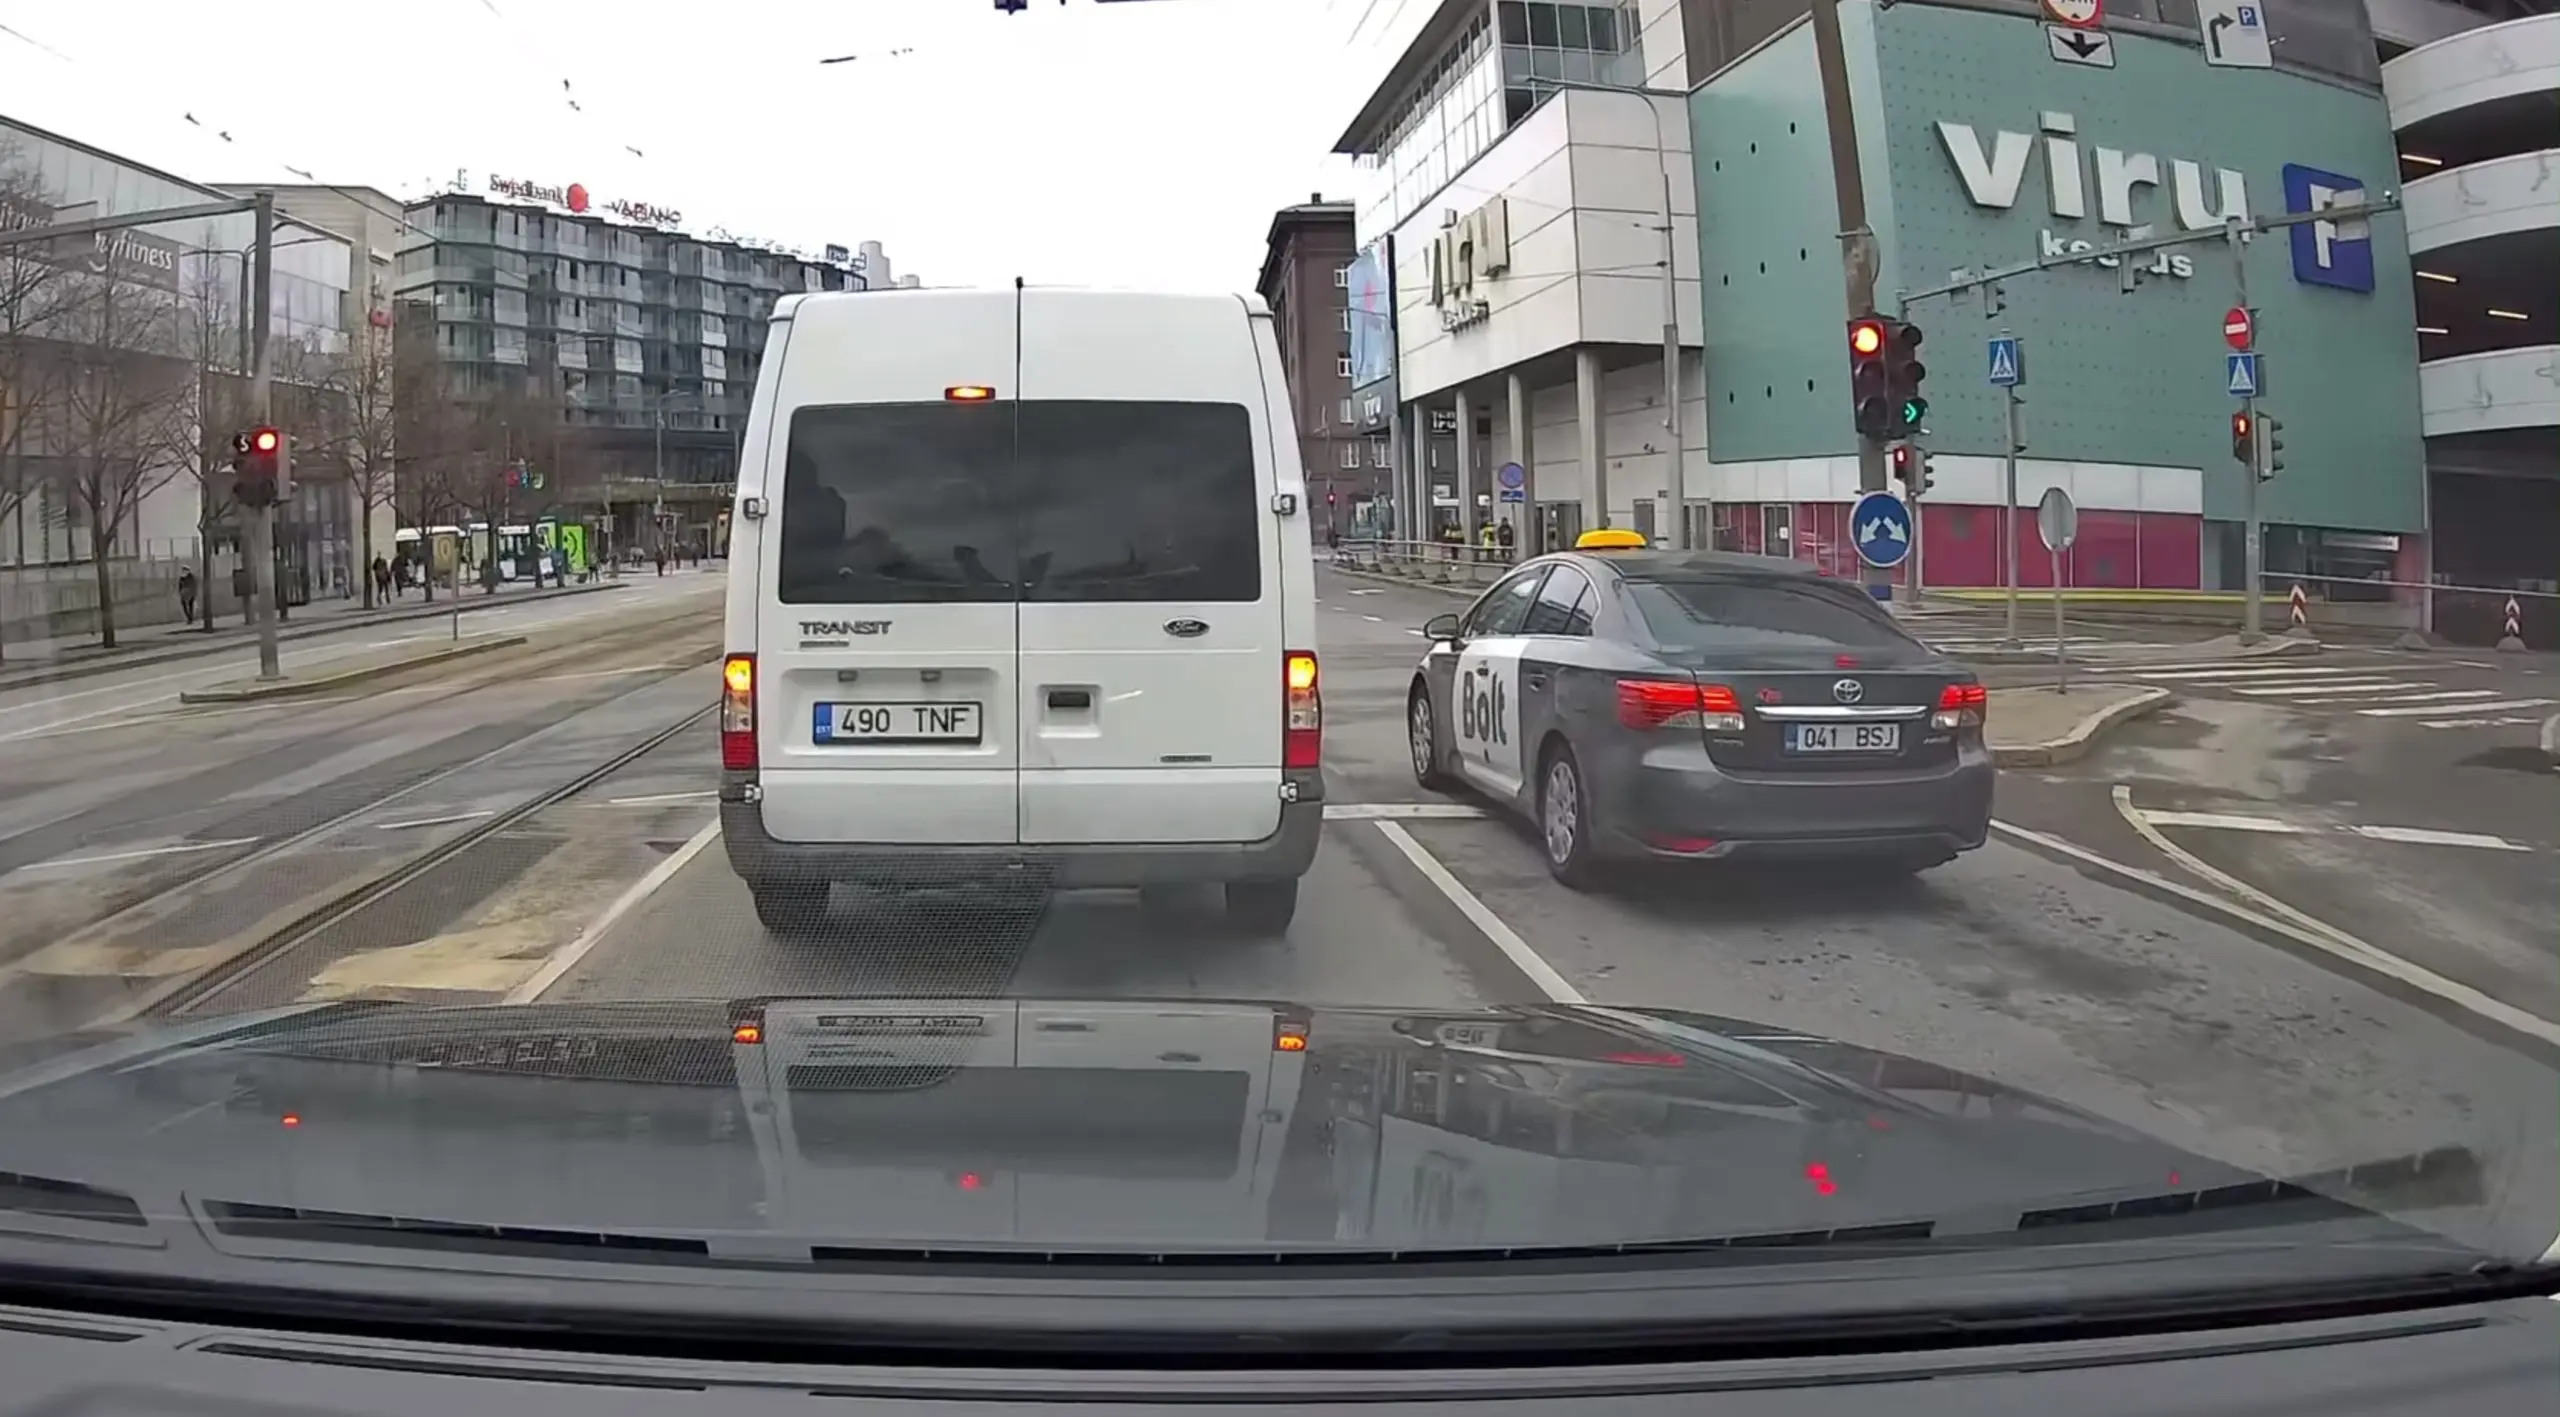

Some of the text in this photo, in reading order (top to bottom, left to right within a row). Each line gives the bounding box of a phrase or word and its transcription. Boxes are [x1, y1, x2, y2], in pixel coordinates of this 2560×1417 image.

[490, 173, 564, 204] Swedbank
[1935, 110, 2251, 243] viru
[798, 620, 893, 635] TRANSIT
[841, 708, 970, 733] 490 TNF
[1463, 671, 1507, 746] Bolt
[1804, 727, 1838, 748] 041
[1855, 726, 1894, 747] BSJ
